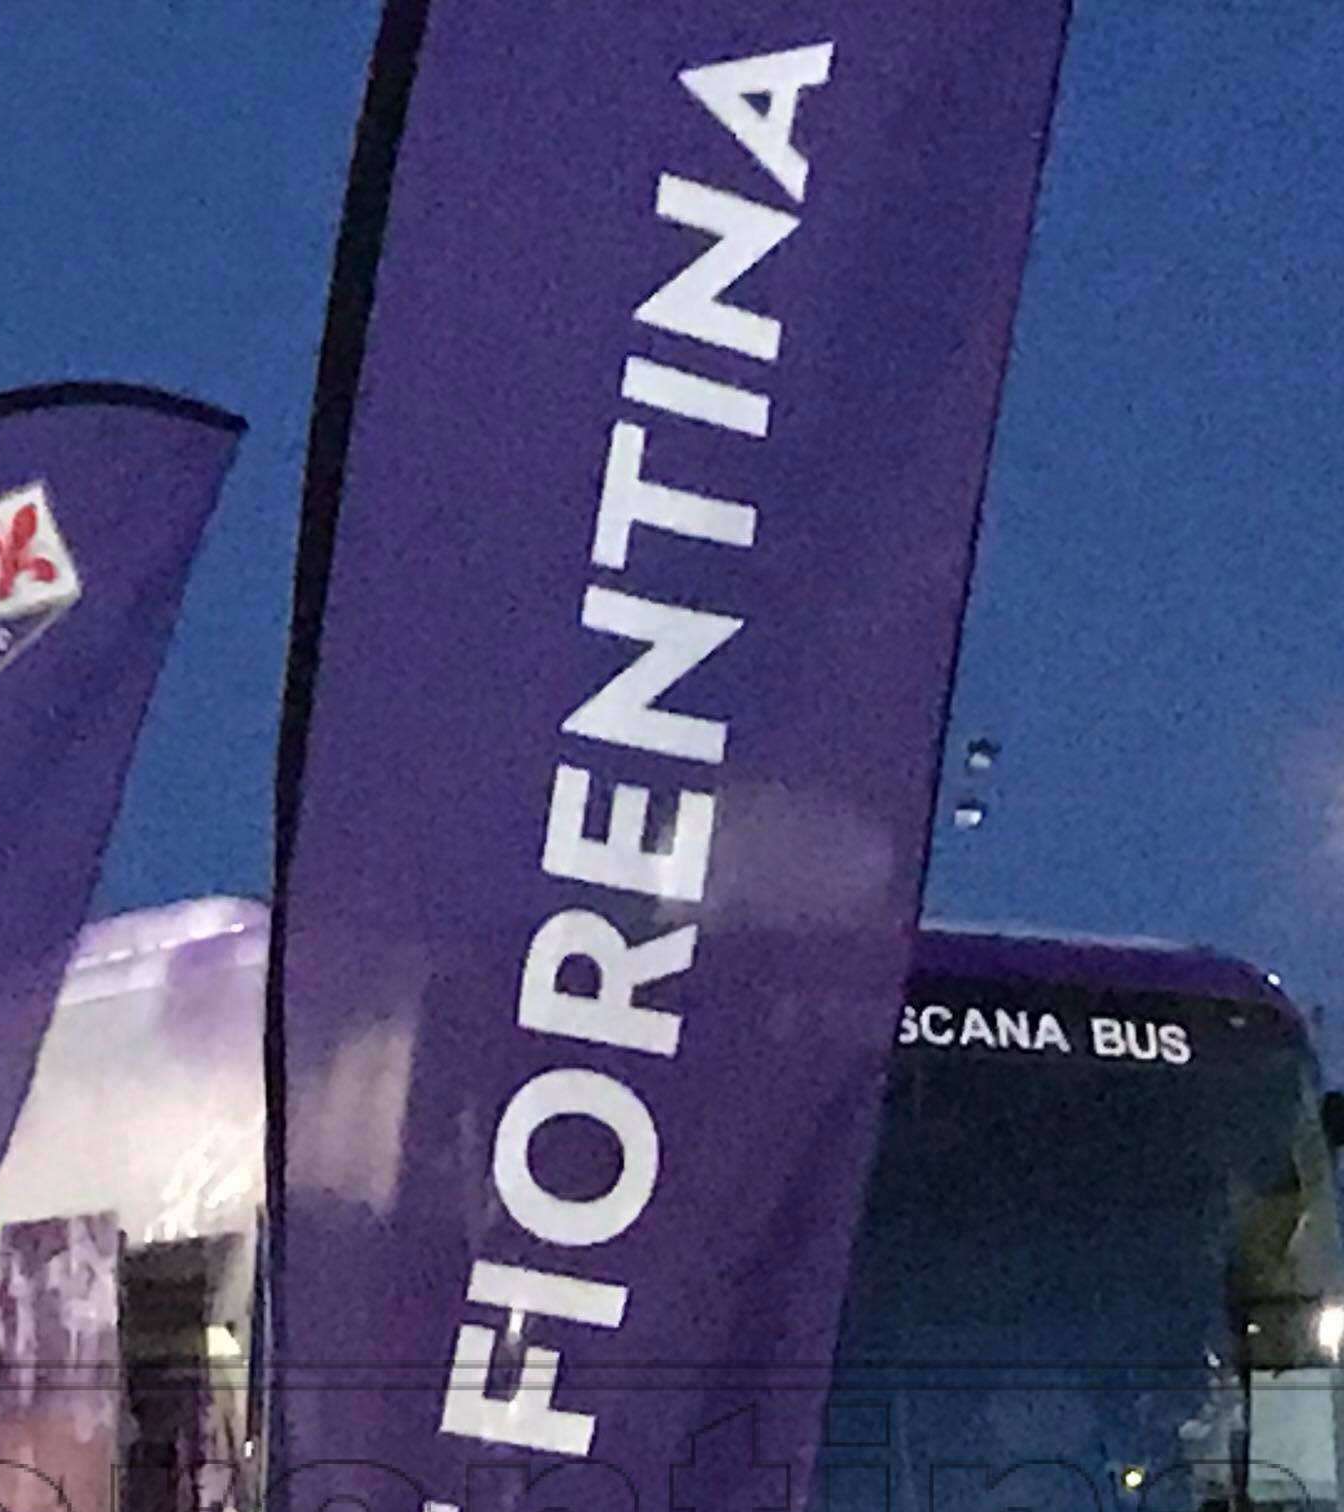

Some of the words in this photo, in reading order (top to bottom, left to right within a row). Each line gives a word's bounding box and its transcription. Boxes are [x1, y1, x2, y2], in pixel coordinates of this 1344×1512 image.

[439, 40, 834, 1457] FIORENTINA
[899, 1005, 1072, 1053] SCANA
[1090, 1017, 1192, 1065] BUS
